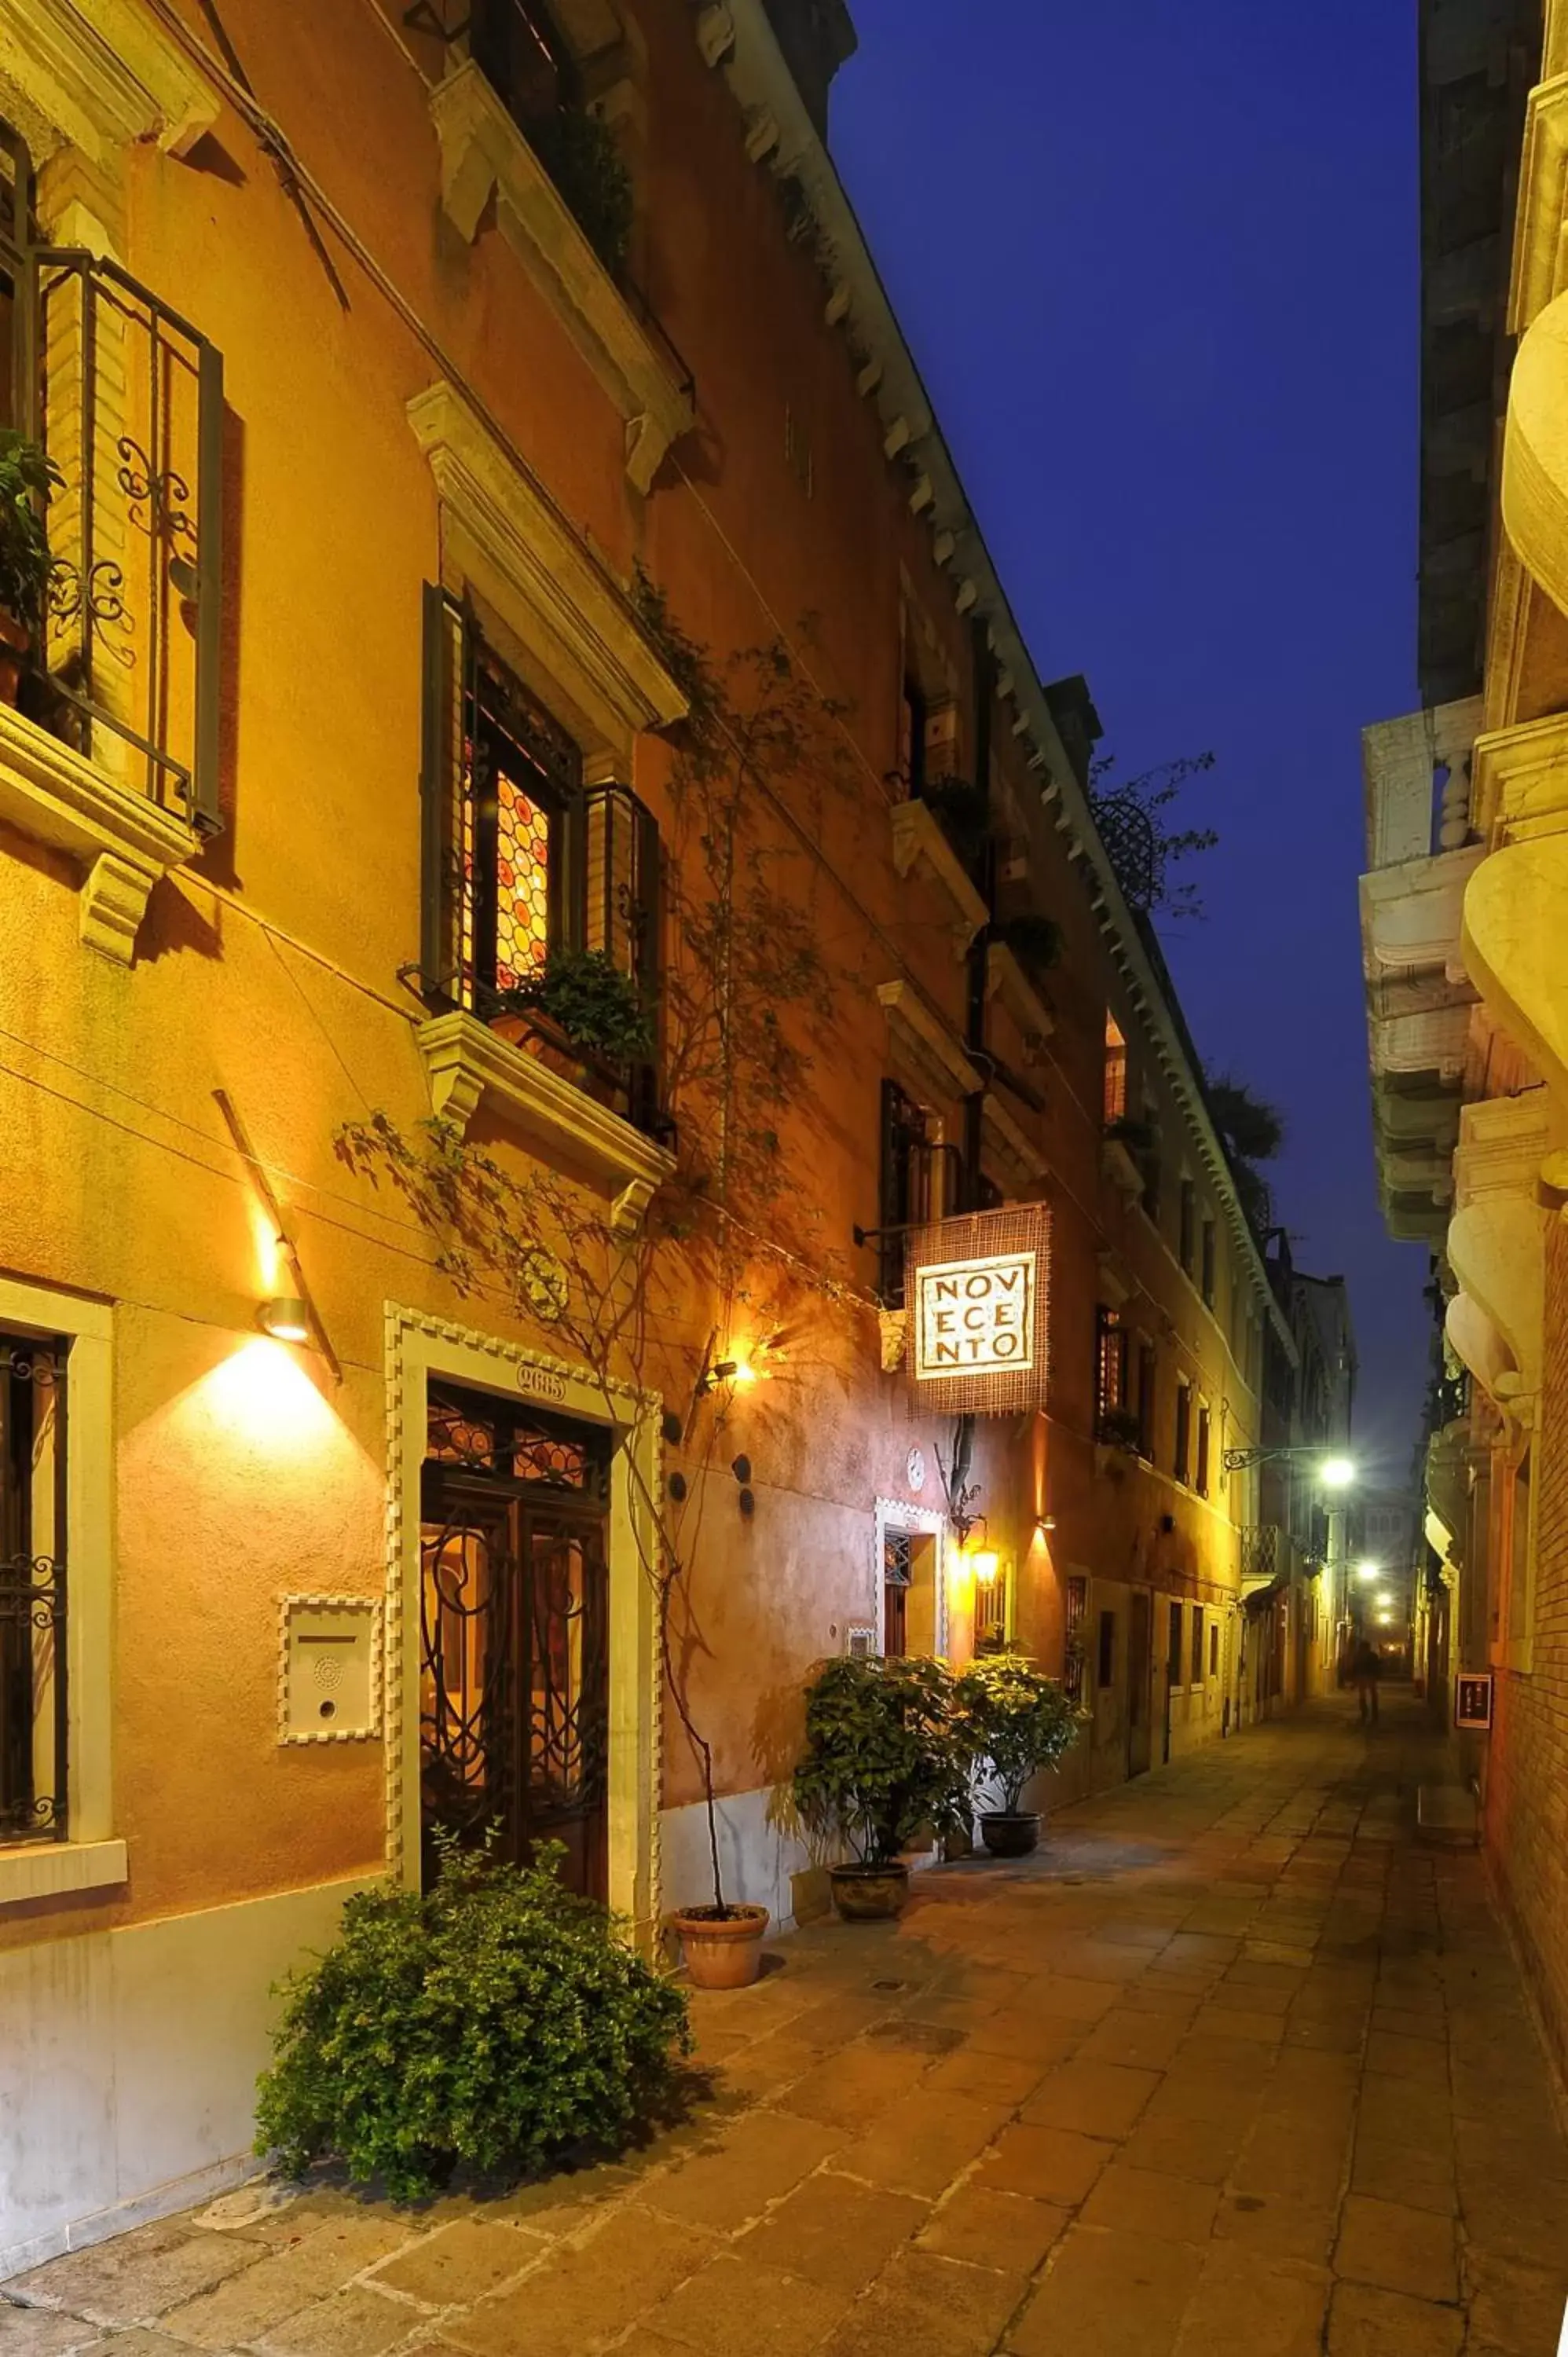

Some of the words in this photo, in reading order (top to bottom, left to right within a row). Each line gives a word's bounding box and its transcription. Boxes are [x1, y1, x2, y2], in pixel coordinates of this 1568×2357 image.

[936, 1270, 1018, 1301] NOV
[935, 1303, 1014, 1332] ECE
[936, 1332, 1018, 1362] NTO
